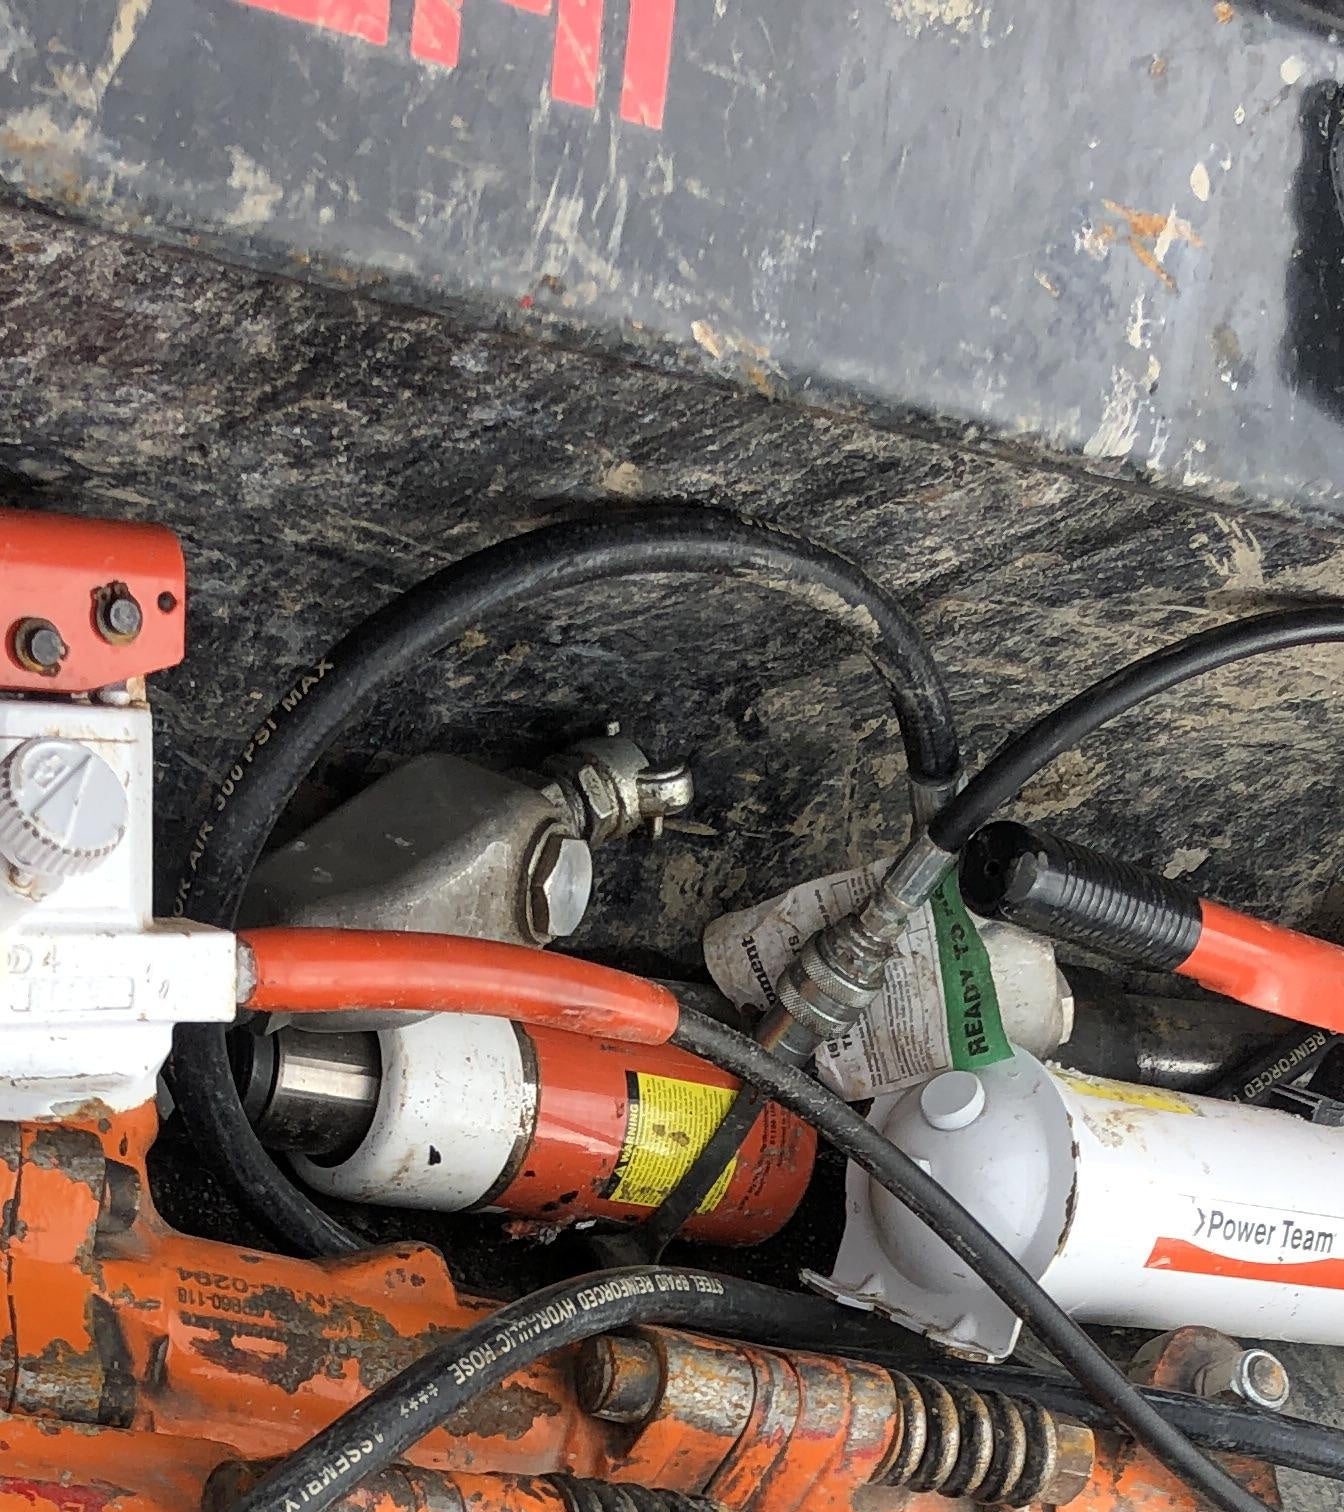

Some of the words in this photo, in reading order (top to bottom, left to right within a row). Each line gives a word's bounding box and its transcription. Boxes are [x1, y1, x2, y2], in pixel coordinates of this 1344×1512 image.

[281, 657, 335, 713] MAX
[950, 923, 969, 961] TO
[959, 969, 990, 1057] READY
[1243, 1031, 1327, 1099] REINFORCED
[620, 1103, 640, 1163] WARNING
[1206, 1210, 1276, 1246] Power
[1281, 1219, 1336, 1254] Team
[577, 1275, 655, 1311] REINFORCED
[655, 1274, 690, 1292] BRAID
[689, 1274, 725, 1296] STEEL
[447, 1342, 497, 1385] HOSE
